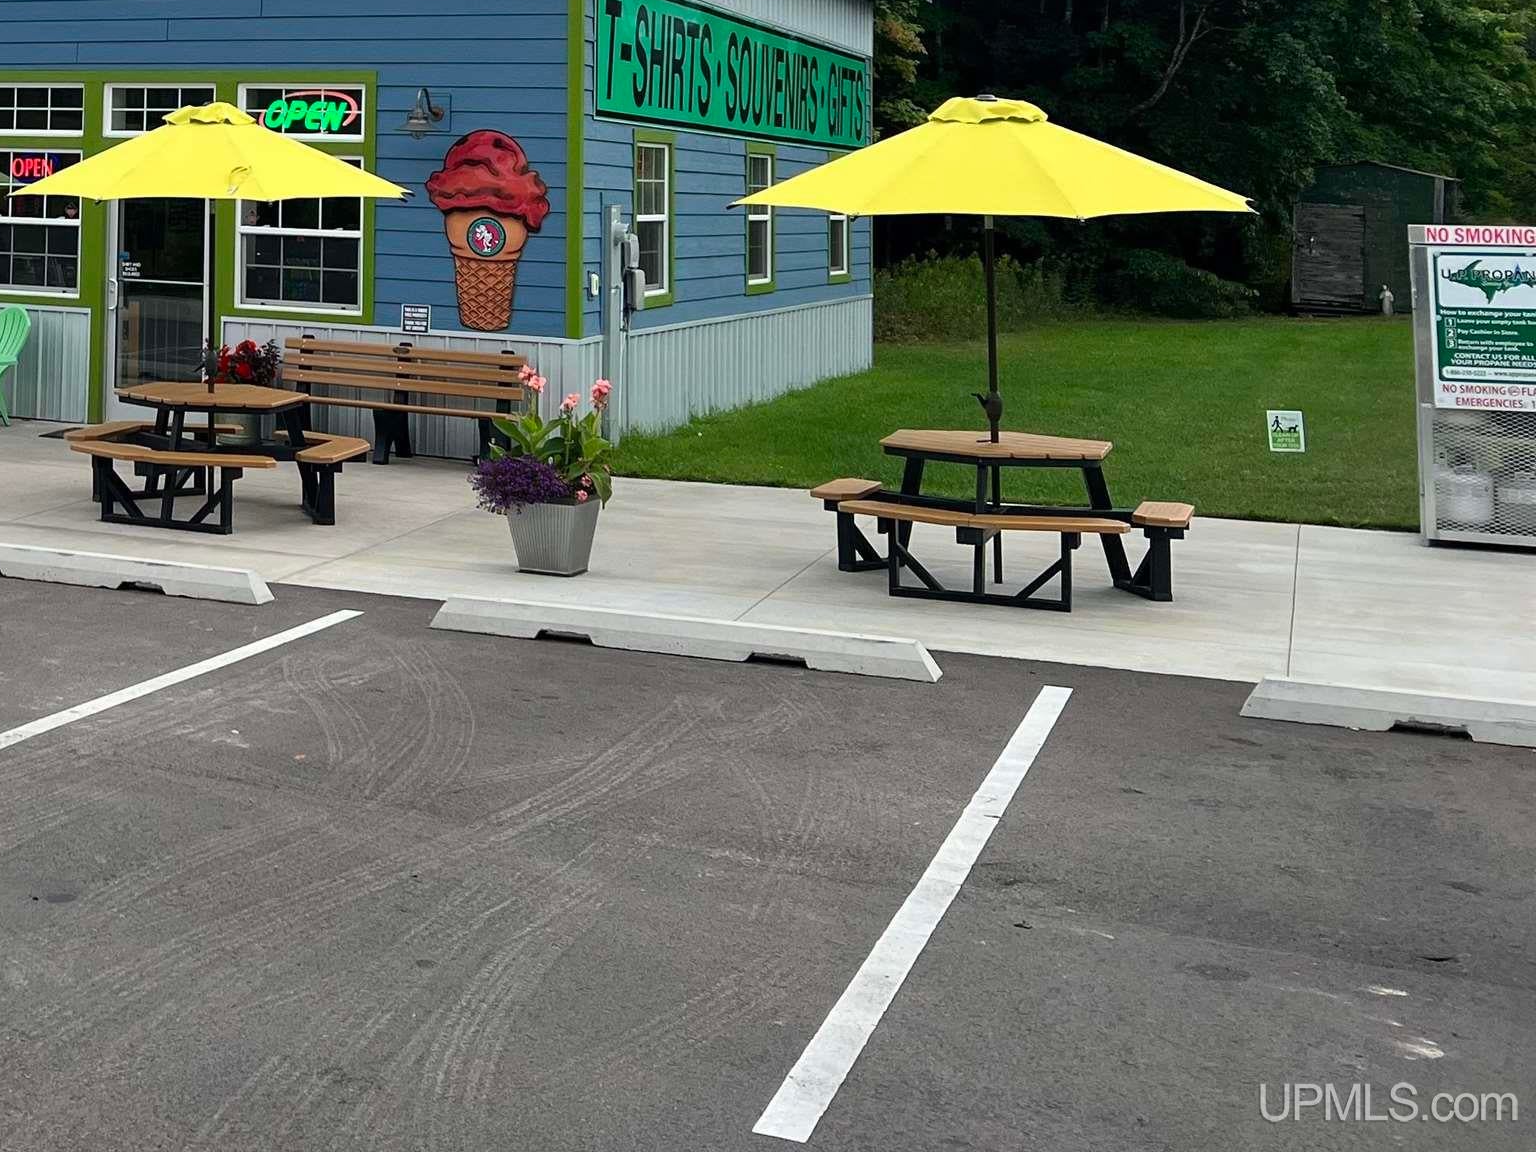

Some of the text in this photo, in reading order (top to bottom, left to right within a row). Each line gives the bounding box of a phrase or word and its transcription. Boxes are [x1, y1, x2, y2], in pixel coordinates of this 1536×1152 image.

[725, 31, 819, 135] SOUVENIRS
[828, 62, 864, 142] GIFTS
[265, 99, 347, 131] OPEN
[13, 158, 53, 177] OPEN
[1426, 227, 1535, 244] NO SMOKING
[1442, 384, 1457, 393] NO
[1459, 385, 1506, 395] SMOKING
